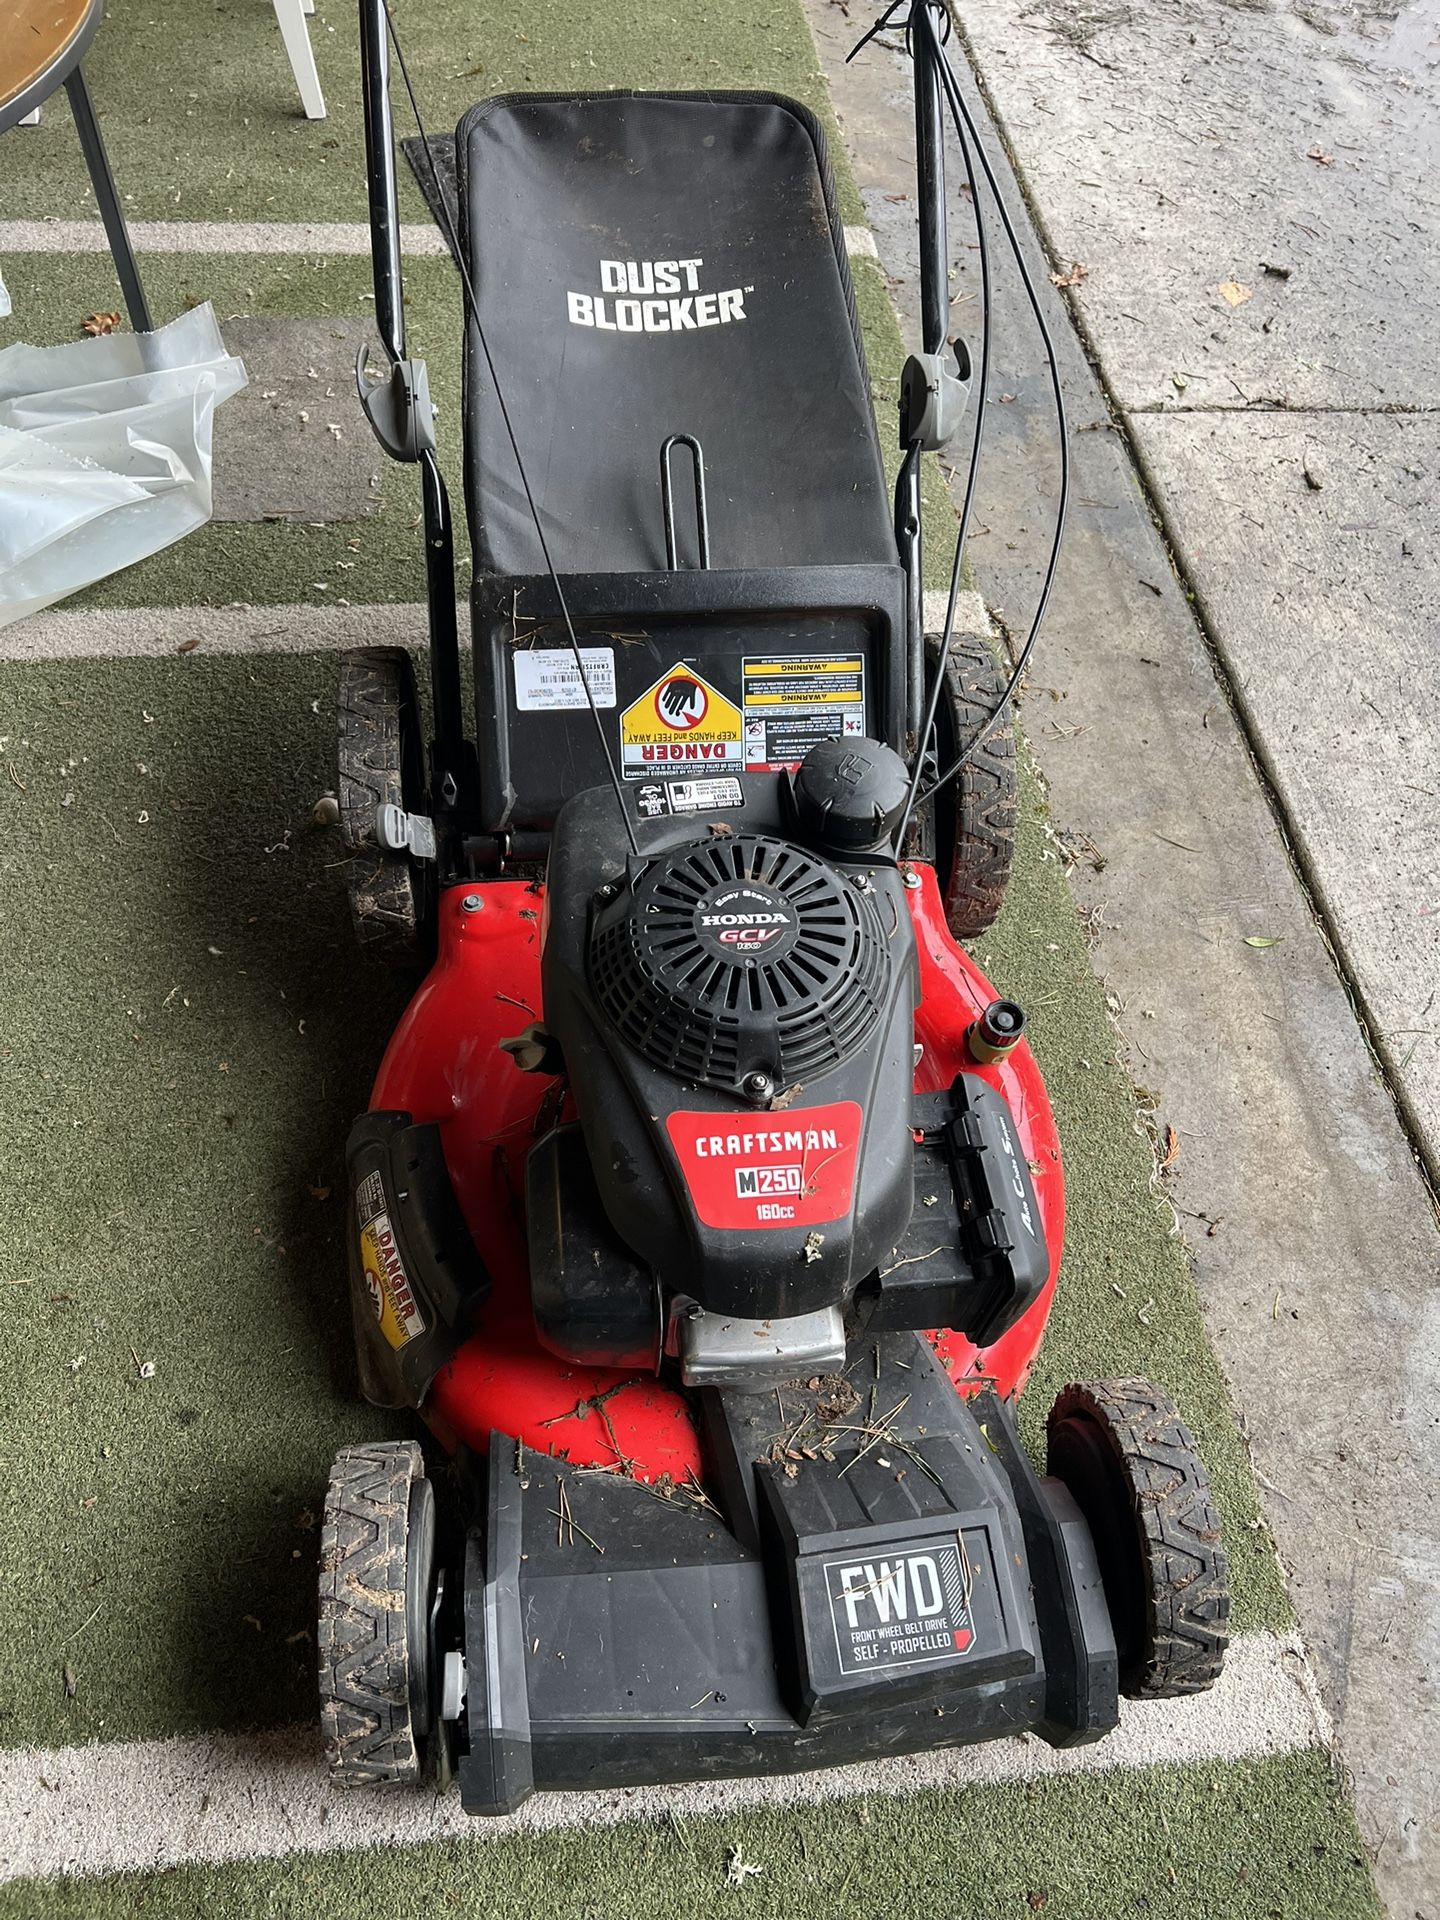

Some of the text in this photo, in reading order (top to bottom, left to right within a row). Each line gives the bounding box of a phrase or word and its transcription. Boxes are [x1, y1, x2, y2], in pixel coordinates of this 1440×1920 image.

[600, 258, 703, 294] DUST
[567, 288, 747, 332] BLOCKER
[628, 731, 737, 742] KEEP HANDS and FEET AWAY
[642, 743, 726, 761] DANGER
[639, 798, 666, 807] 10W30
[714, 890, 772, 907] Easy Start
[701, 913, 791, 926] HONDA
[719, 928, 781, 942] GCV
[695, 1129, 838, 1157] CRAFTSMAN
[738, 1168, 801, 1194] M250
[378, 1230, 416, 1321] DANGER
[375, 1250, 387, 1278] HANDS
[387, 1293, 399, 1313] FEET
[394, 1313, 410, 1338] AWAY
[840, 1556, 944, 1628] FWD
[851, 1617, 948, 1644] FRONT WHEEL BELT DRIVE
[854, 1644, 880, 1662] SELF
[890, 1632, 951, 1656] PROPELLED
